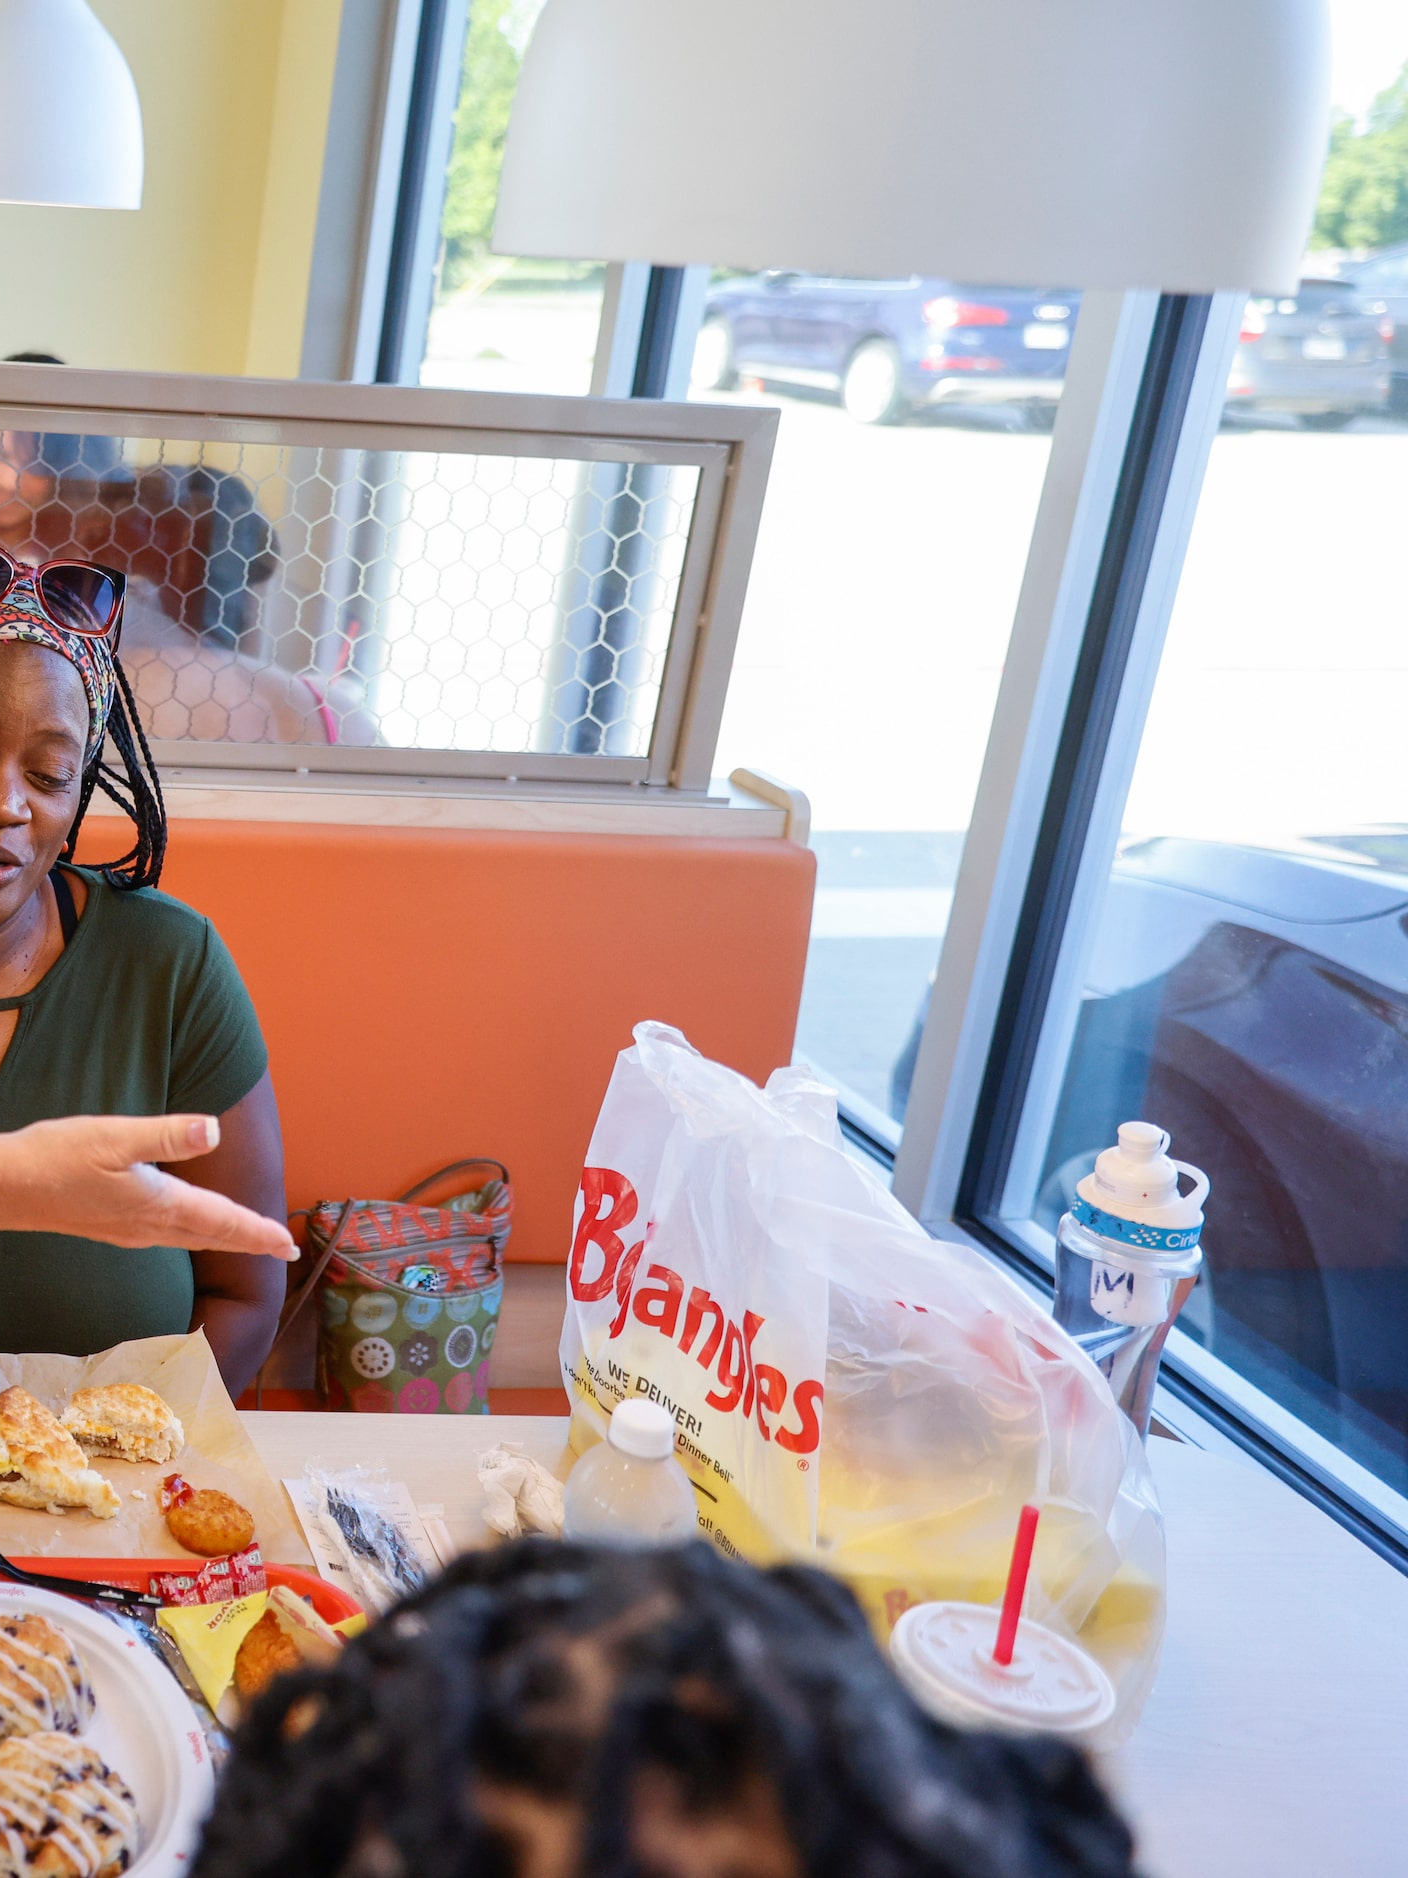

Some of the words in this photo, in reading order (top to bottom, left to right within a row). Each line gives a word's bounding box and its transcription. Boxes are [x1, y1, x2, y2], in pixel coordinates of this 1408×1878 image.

[594, 1370, 626, 1401] Doorbe
[608, 1359, 631, 1390] WE
[635, 1376, 702, 1438] DELIVER!
[677, 1433, 712, 1466] Dinner
